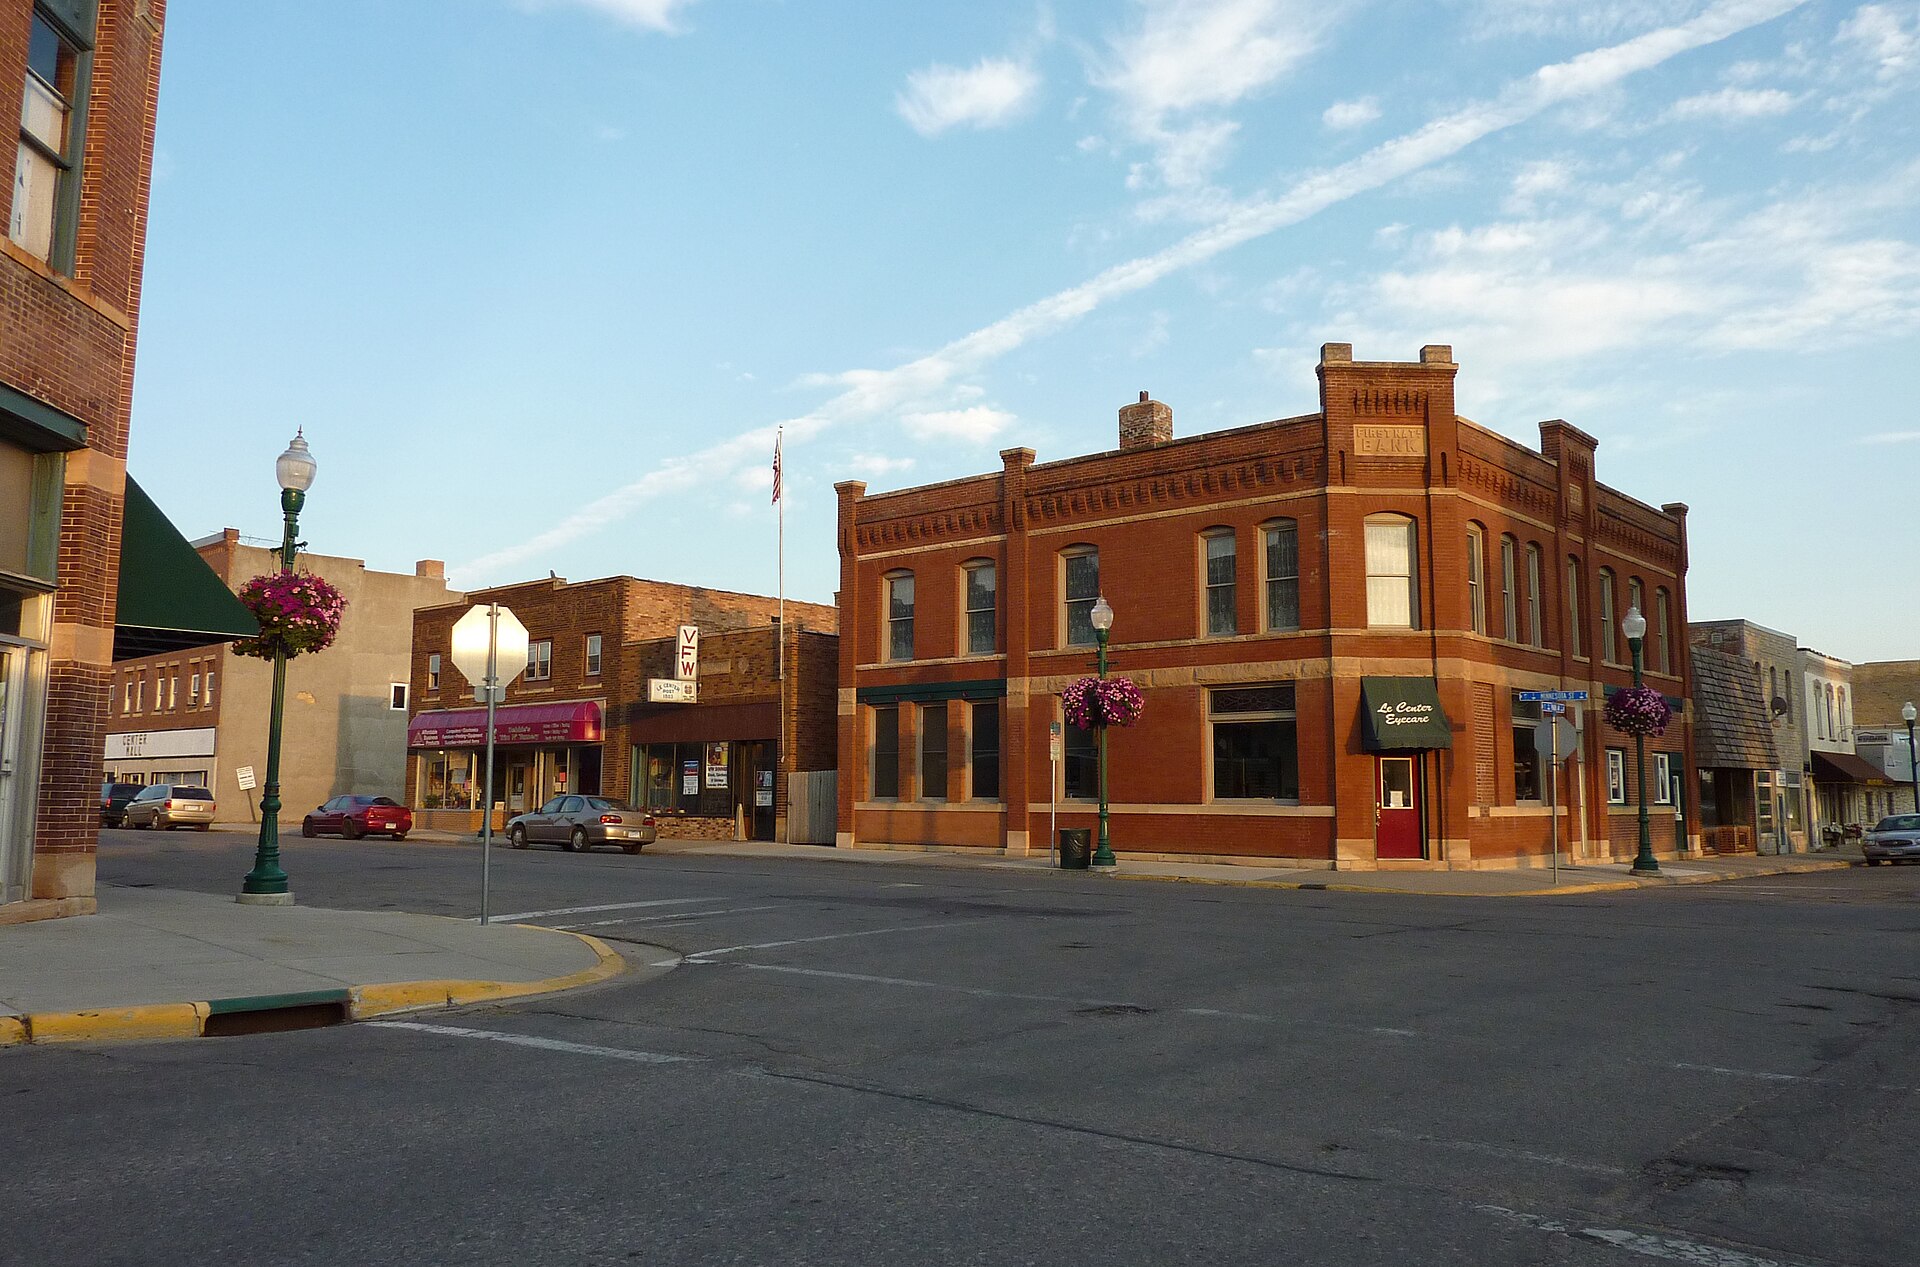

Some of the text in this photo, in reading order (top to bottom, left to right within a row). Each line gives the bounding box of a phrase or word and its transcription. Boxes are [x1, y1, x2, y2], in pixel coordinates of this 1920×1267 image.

[1356, 428, 1391, 439] FIRST
[1361, 439, 1418, 453] BANK
[681, 629, 697, 676] VFW
[663, 683, 680, 692] CENTER
[1376, 701, 1433, 713] Le Center
[1385, 713, 1430, 726] Eyecare
[123, 733, 148, 746] CENTER
